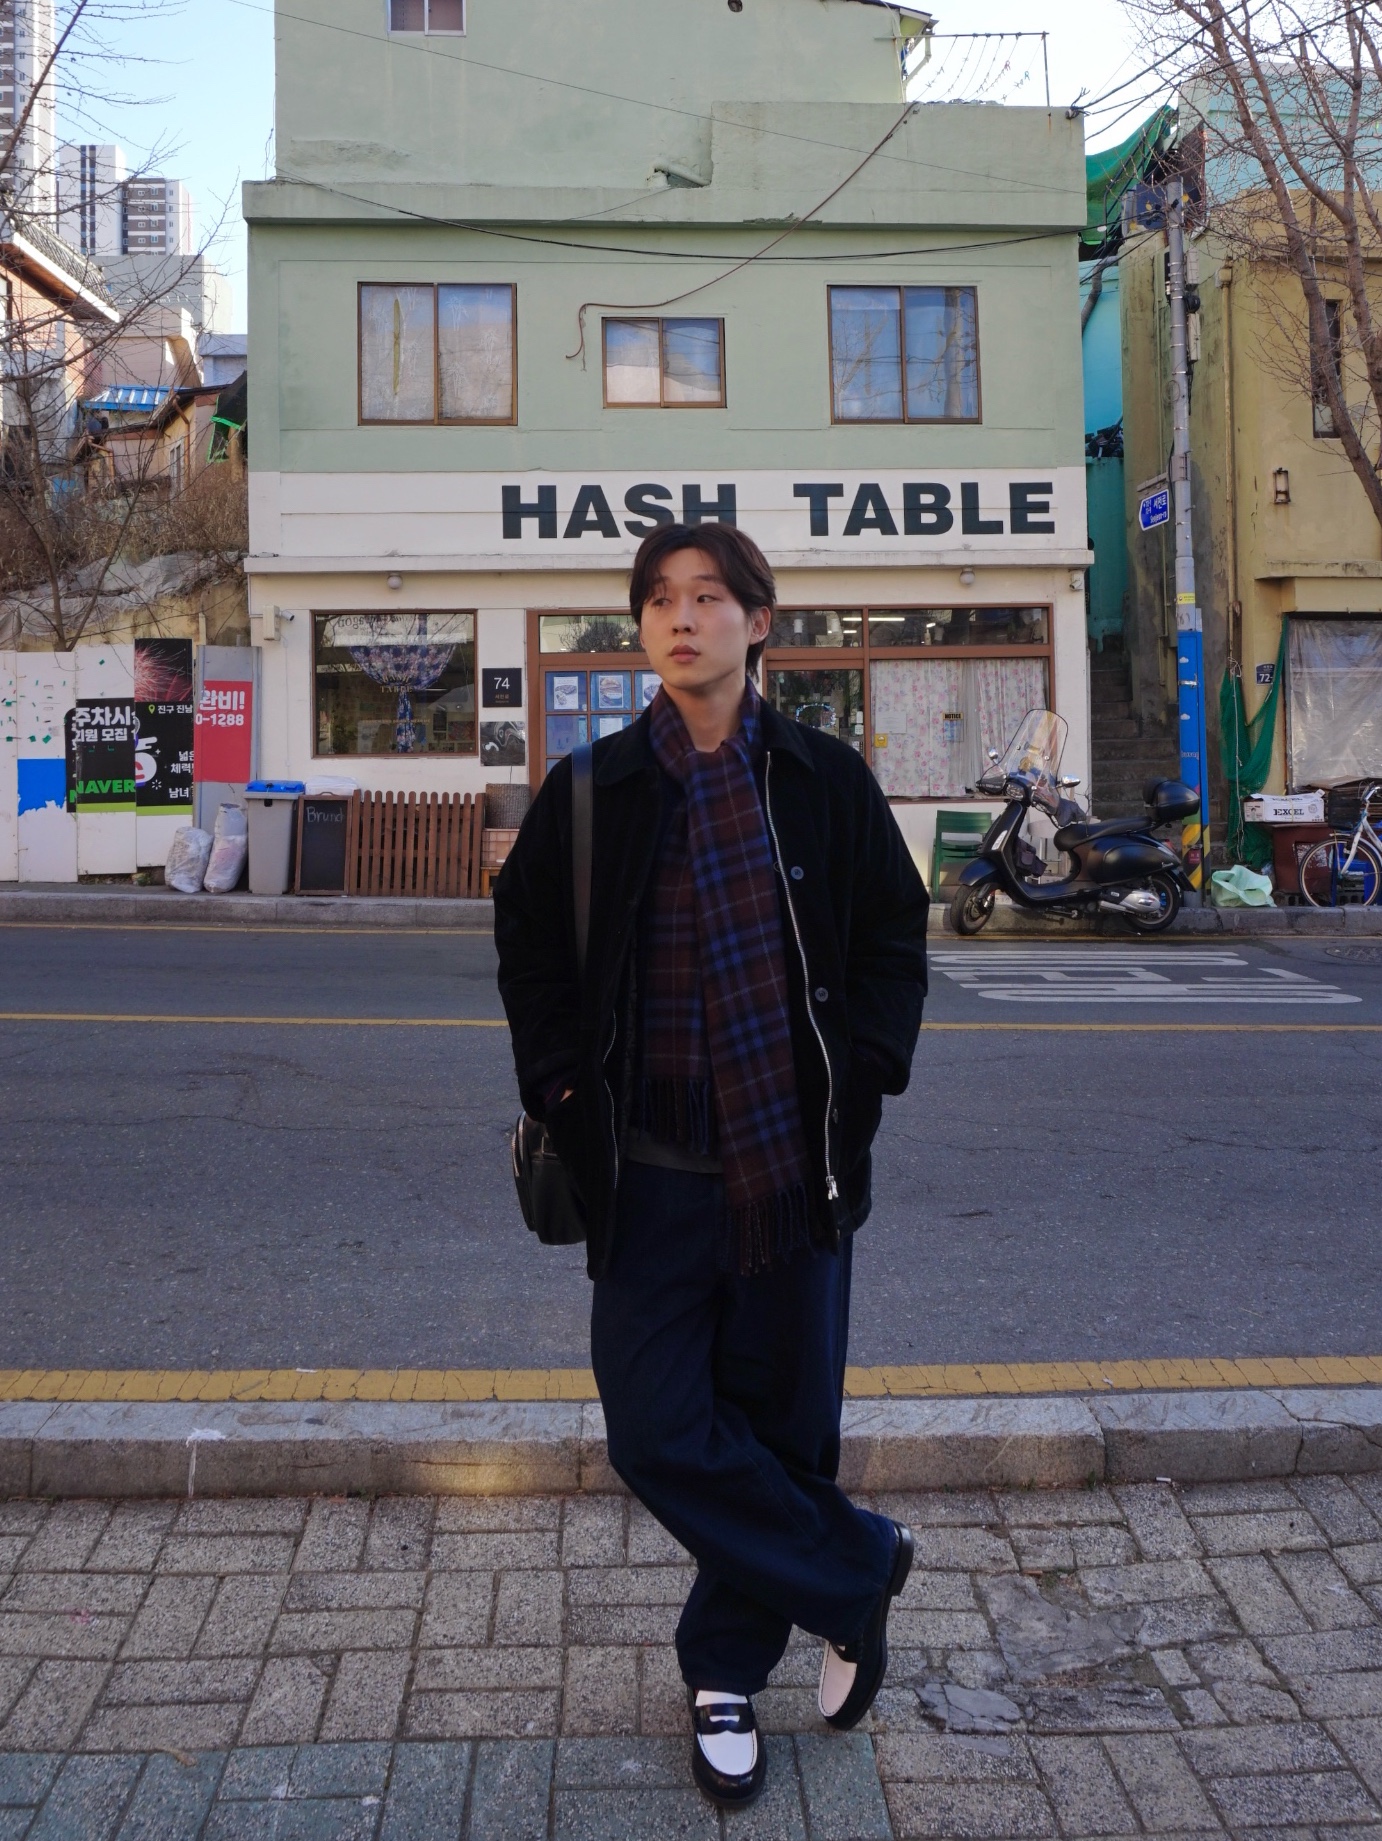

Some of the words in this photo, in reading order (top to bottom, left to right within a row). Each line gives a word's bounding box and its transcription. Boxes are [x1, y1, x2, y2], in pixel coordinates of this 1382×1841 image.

[502, 483, 737, 539] HASH
[793, 482, 1055, 536] TABLE
[494, 677, 510, 690] 74
[157, 705, 175, 714] 진구
[74, 706, 135, 727] 주차시
[101, 728, 128, 742] 모집
[170, 763, 194, 774] 체력
[168, 787, 189, 799] 남녀
[1273, 808, 1305, 816] EXCEL
